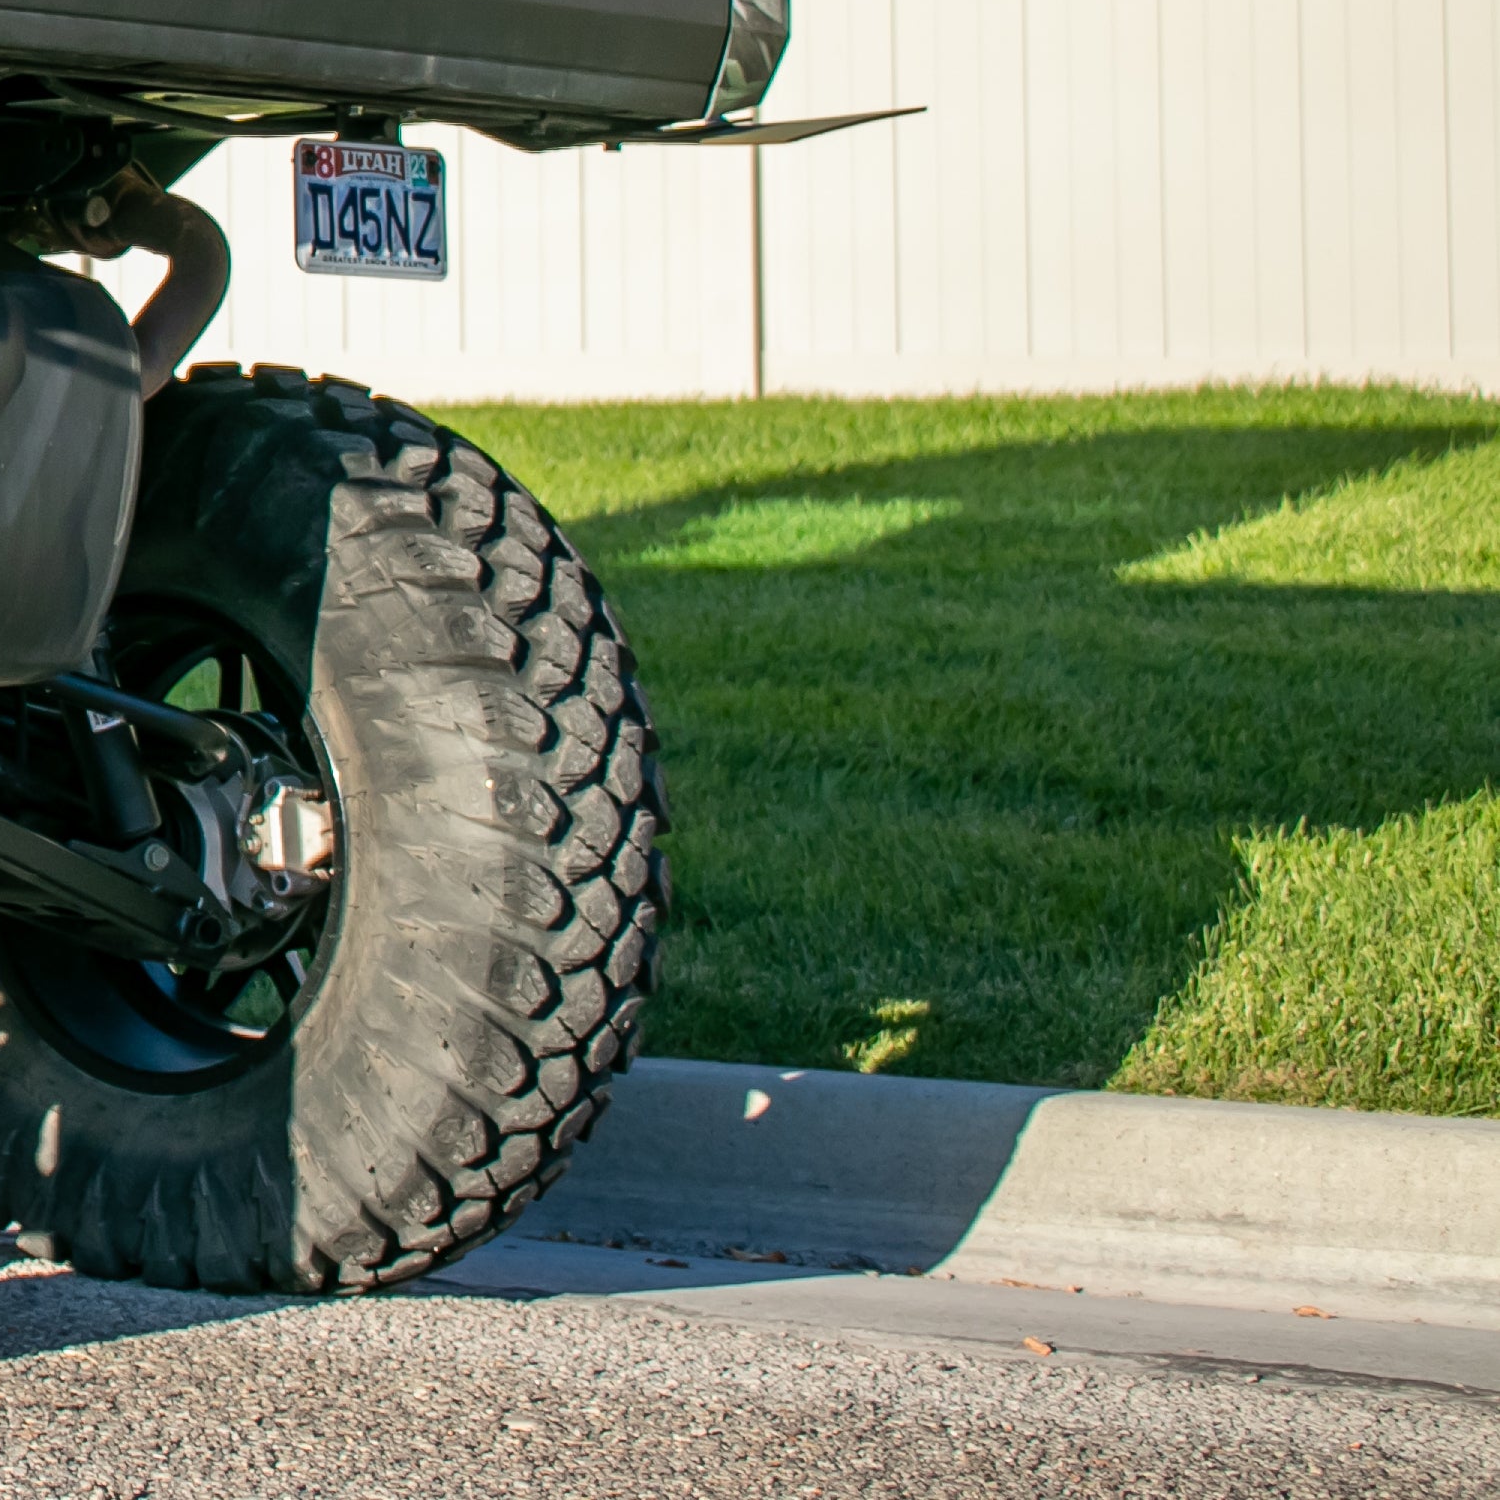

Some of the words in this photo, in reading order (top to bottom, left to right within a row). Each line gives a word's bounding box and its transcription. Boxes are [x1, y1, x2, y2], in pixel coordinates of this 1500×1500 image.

[315, 146, 334, 179] 8
[340, 149, 402, 176] UTAH
[410, 154, 427, 180] 23
[308, 182, 439, 259] D45NZ
